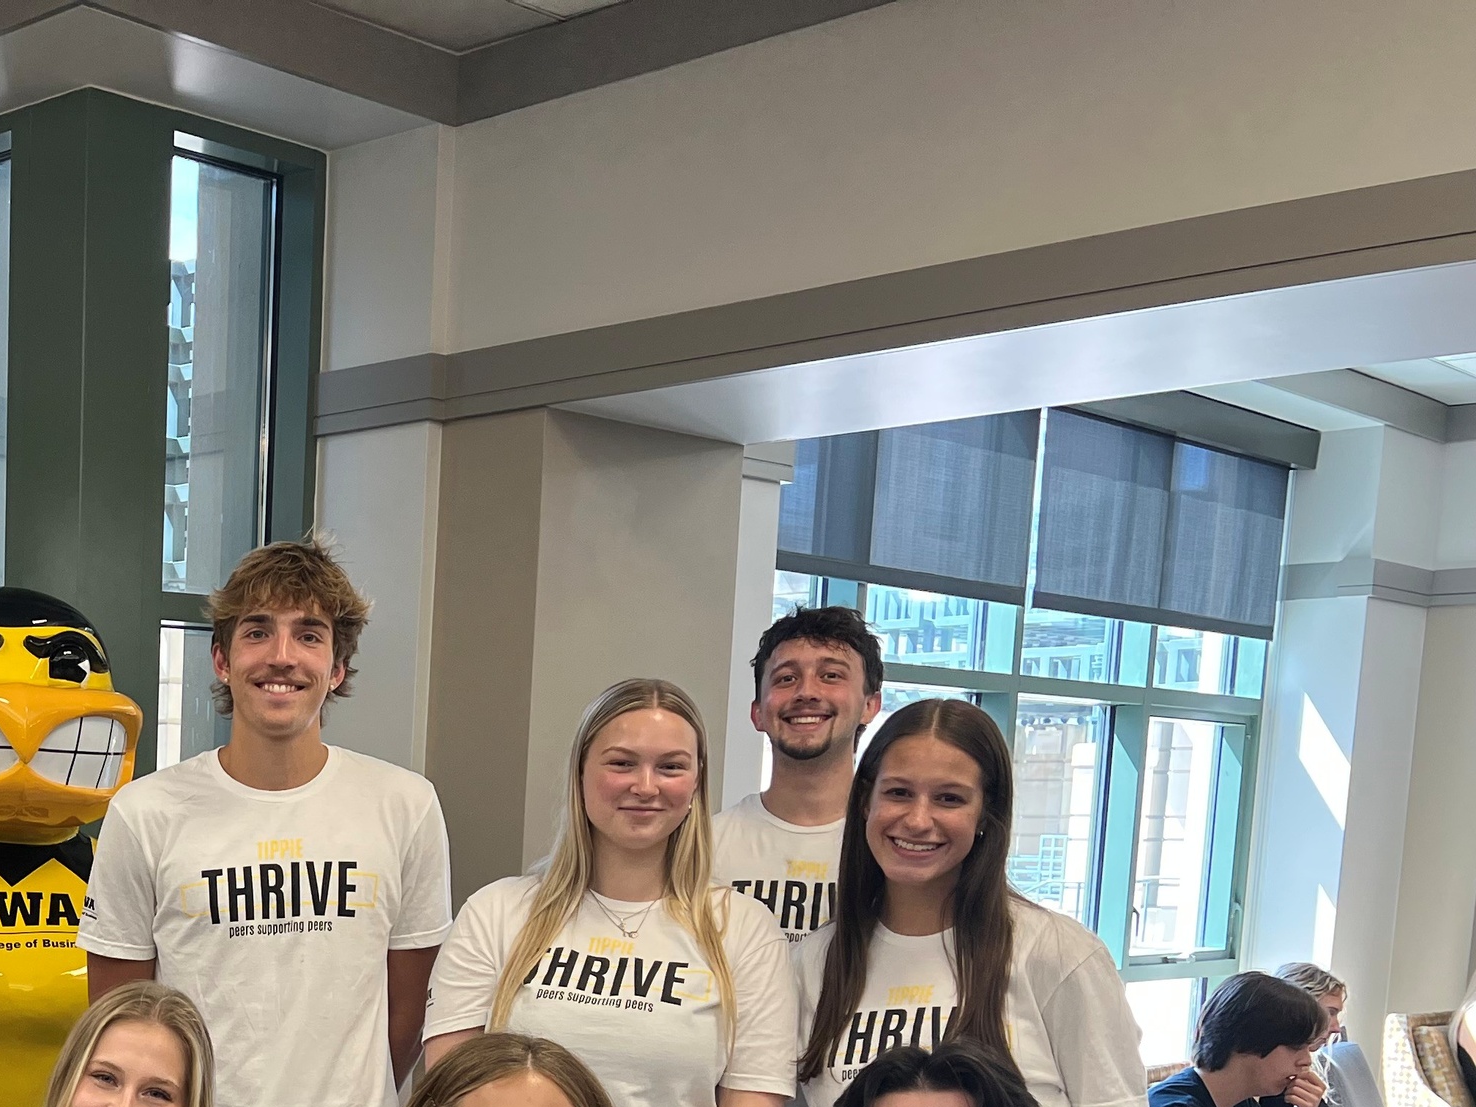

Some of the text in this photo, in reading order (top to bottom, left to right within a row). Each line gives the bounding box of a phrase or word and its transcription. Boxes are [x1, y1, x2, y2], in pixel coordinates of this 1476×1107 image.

[257, 838, 303, 860] TIPPIE
[201, 861, 357, 924] THRIVE
[732, 880, 836, 930] HRI
[229, 920, 333, 938] peers supporting peers
[25, 938, 38, 948] of
[536, 988, 653, 1013] peers supporting peers
[827, 1006, 957, 1068] HRIV
[842, 1067, 861, 1083] pee
